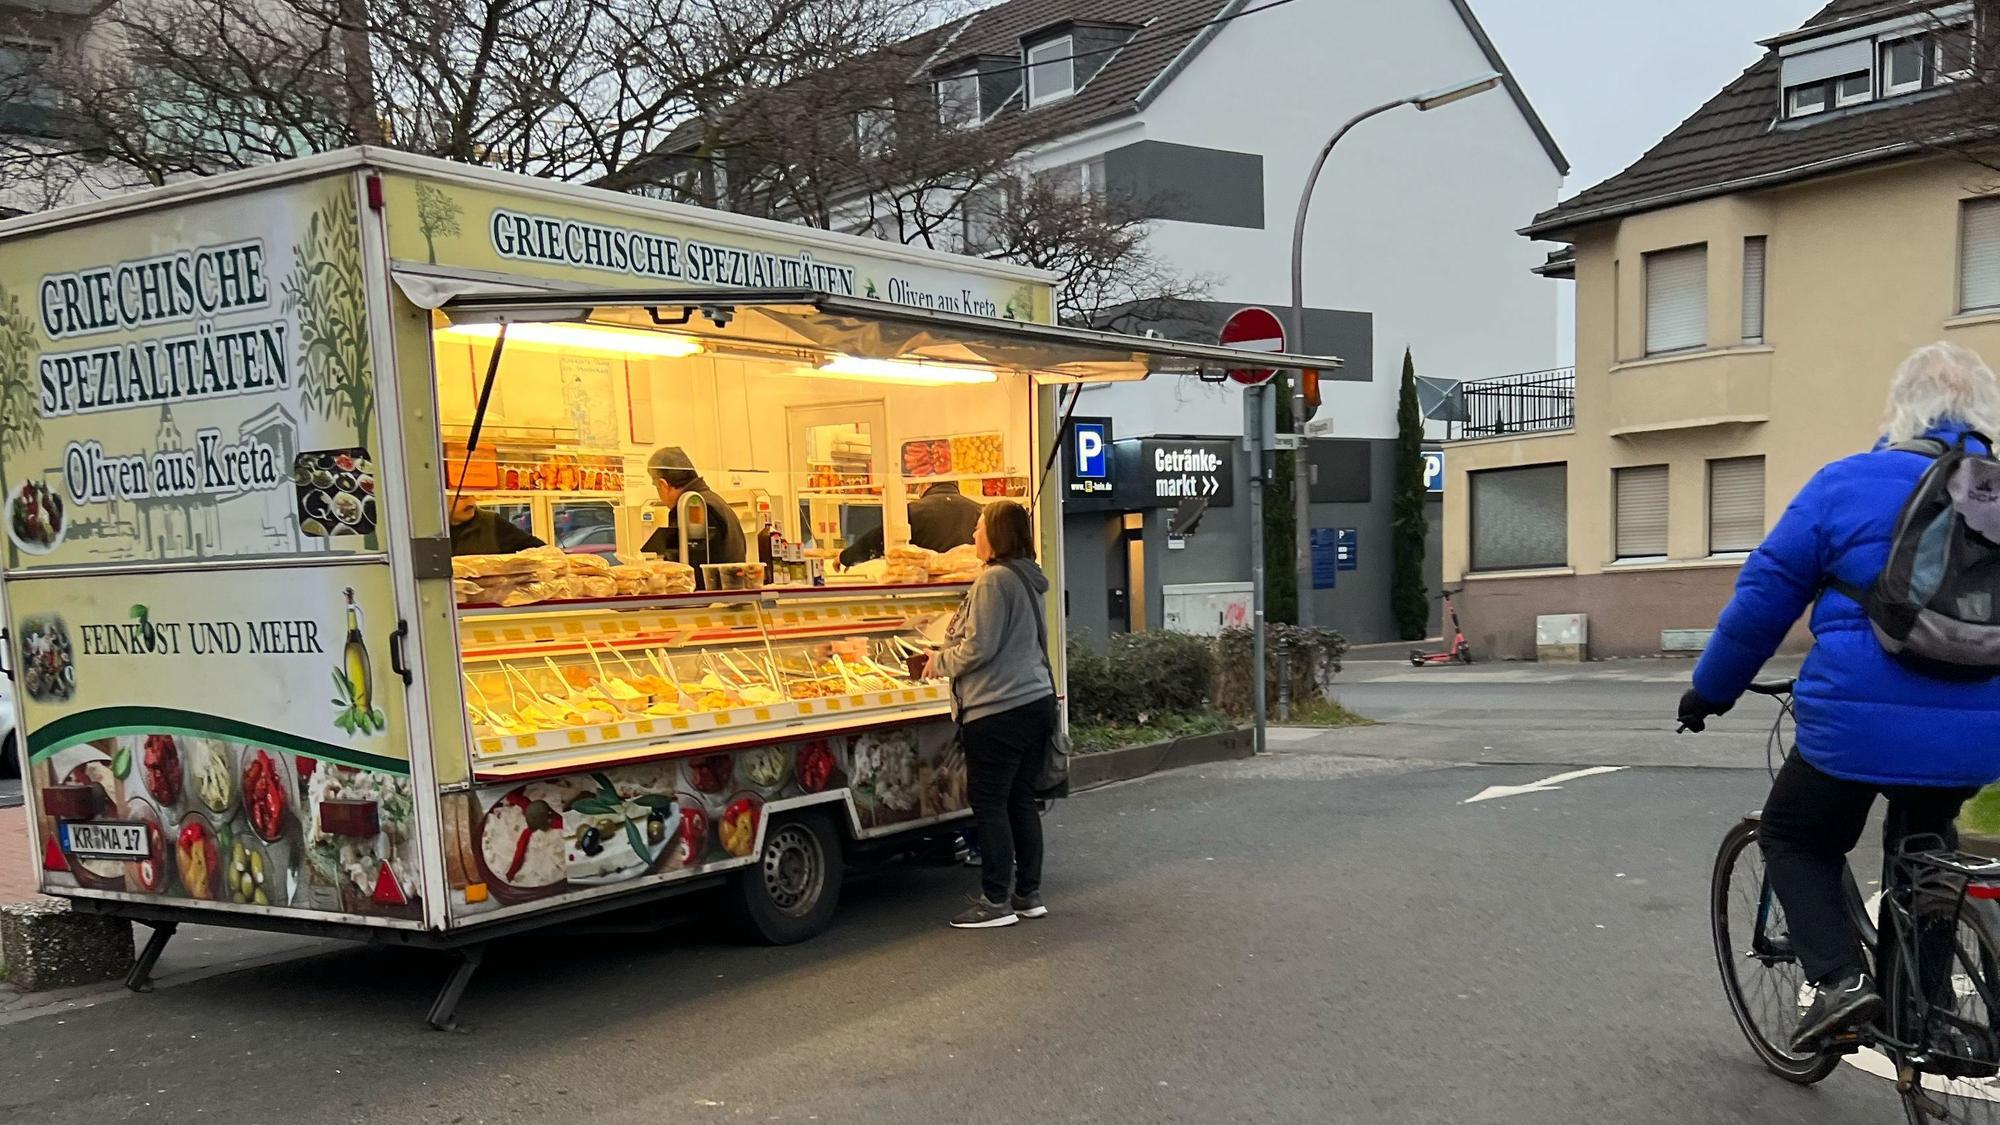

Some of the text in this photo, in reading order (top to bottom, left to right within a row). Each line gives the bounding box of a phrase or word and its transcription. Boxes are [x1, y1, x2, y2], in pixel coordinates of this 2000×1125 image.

[494, 213, 853, 296] GRIECHISCHE SPEZIALITÄTEN
[41, 245, 267, 336] GRIECHISCHE
[888, 278, 997, 317] Oliven aus Kreta
[40, 324, 287, 413] SPEZIALITÄTEN
[66, 434, 276, 500] Oliven aus Kreta
[1079, 431, 1102, 472] P
[1155, 448, 1222, 472] Getränke-
[1156, 474, 1197, 496] markt
[1423, 456, 1440, 488] P
[80, 620, 323, 655] FEINKOST UND MEHR
[73, 826, 140, 850] KR MA 17
